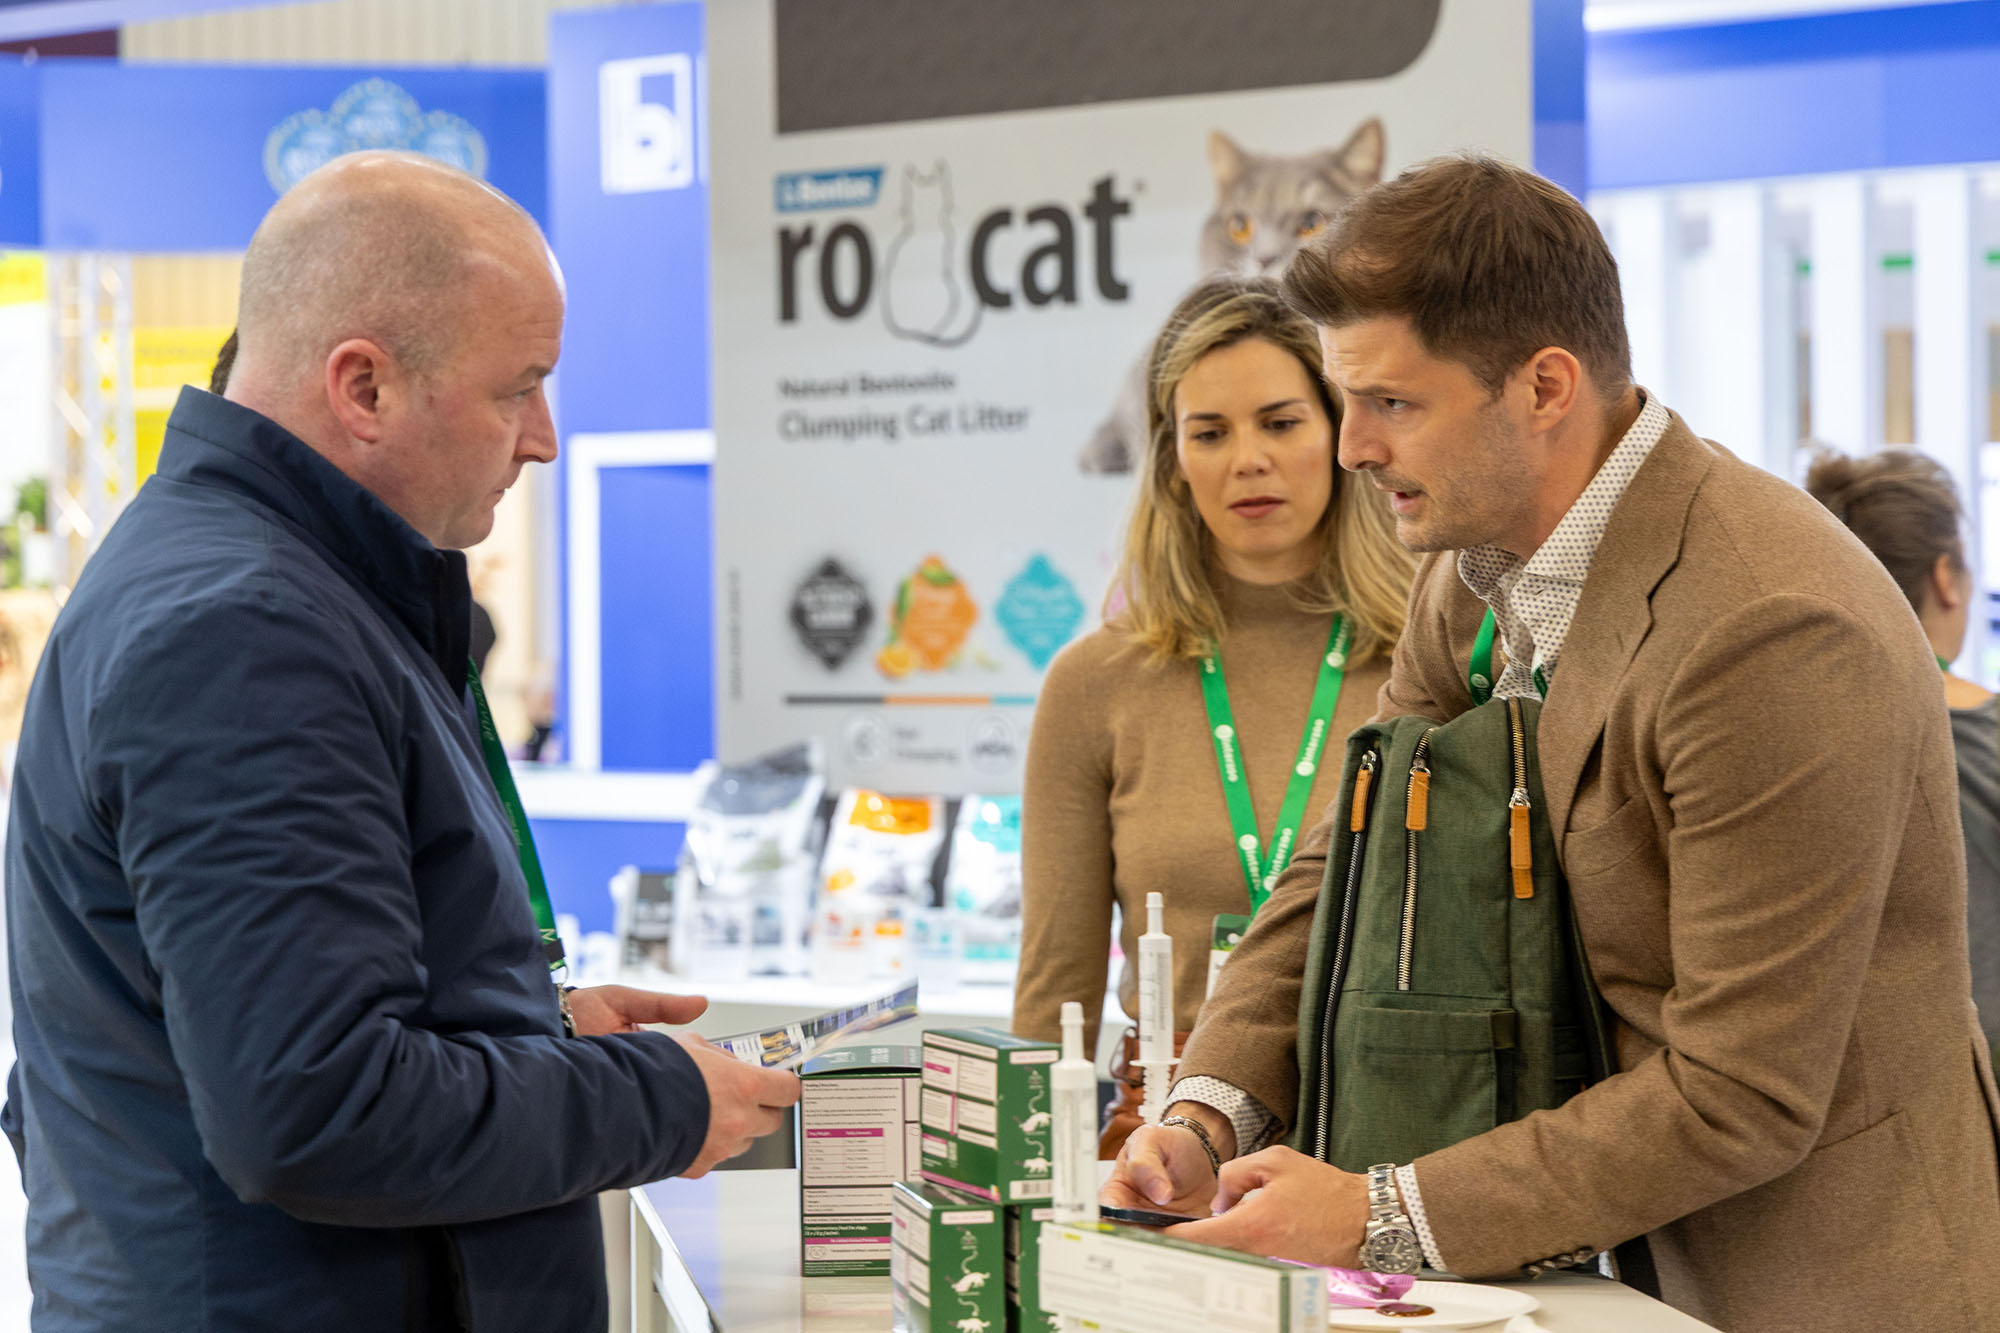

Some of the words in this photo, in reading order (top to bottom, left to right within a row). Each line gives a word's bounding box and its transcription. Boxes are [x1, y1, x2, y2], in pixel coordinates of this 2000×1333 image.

[968, 175, 1131, 309] cat
[779, 377, 850, 397] Natural
[859, 371, 956, 394] Bentonite
[778, 407, 899, 442] Clumping
[906, 403, 956, 434] Cat
[964, 402, 1031, 432] Litter
[1271, 827, 1293, 877] interzoo
